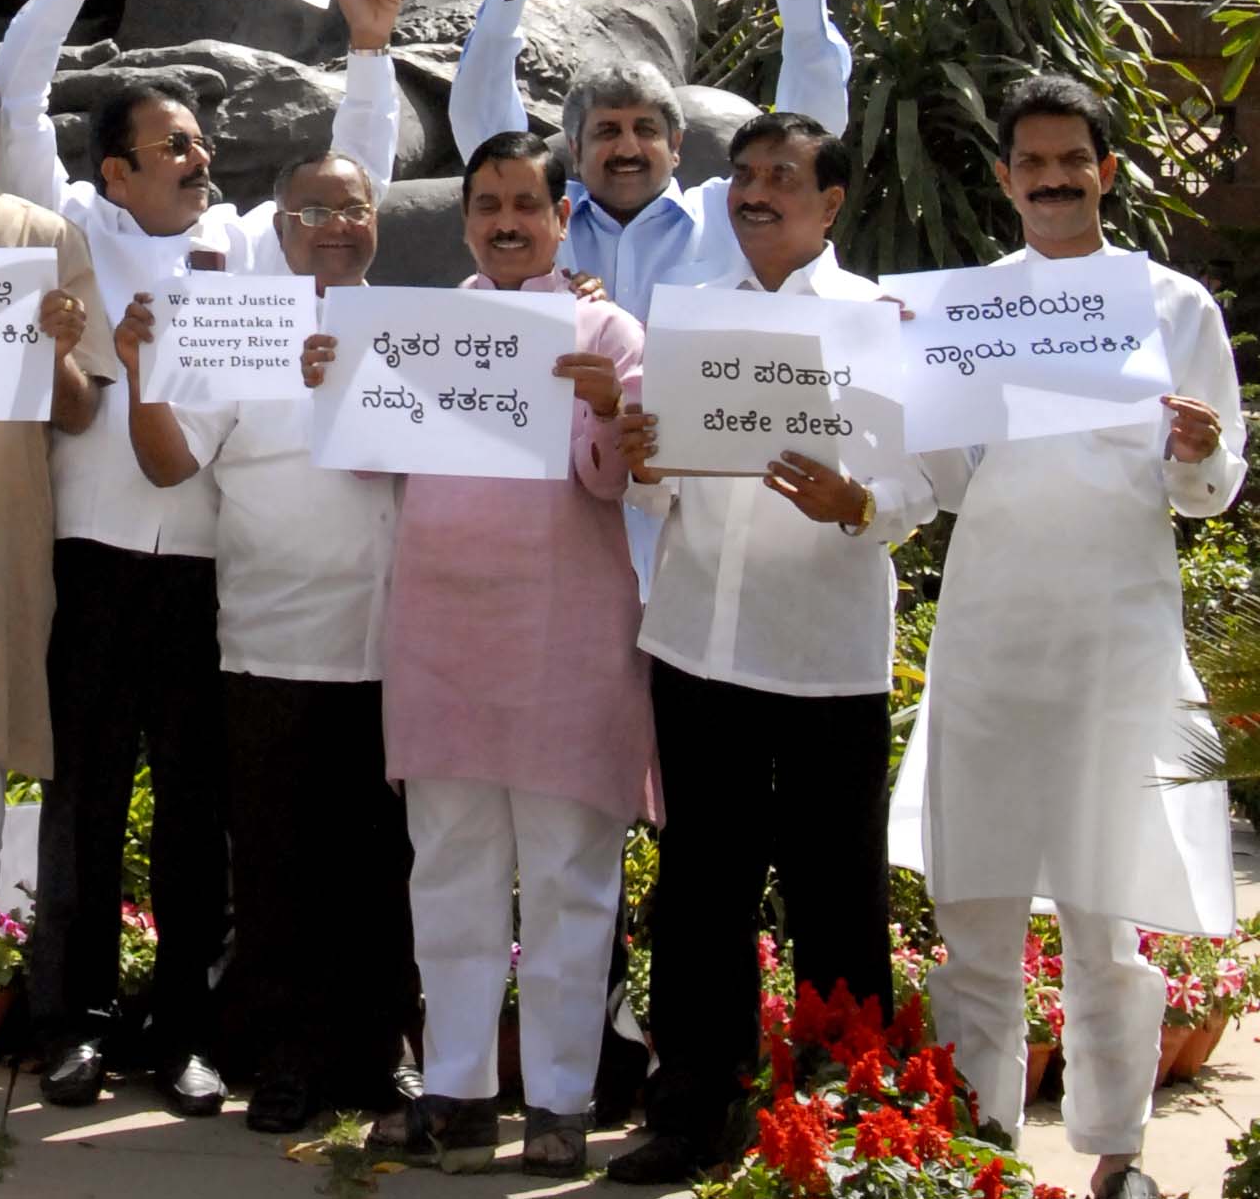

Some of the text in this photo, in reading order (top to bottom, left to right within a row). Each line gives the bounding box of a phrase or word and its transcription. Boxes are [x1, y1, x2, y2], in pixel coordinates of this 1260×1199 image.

[168, 294, 296, 305] We want Justice
[946, 291, 1105, 321] ಕಾವೇರಿಯಲ್ಲಿ
[172, 316, 294, 328] to Karnataka in
[178, 336, 290, 349] Cauvery River
[373, 332, 518, 369] ರೈತರ ರಕ್ಷಣೆ
[925, 335, 1140, 376] ನ್ಯಾಯ ದೊರಕಿಸಿ
[179, 356, 289, 369] Water Dispute
[701, 358, 852, 386] ಬರ ಪರಿಹಾರ
[362, 385, 528, 427] ನಮ್ಮ ಕರ್ತವ್ಯ
[703, 408, 853, 436] ಬೇಕೇ ಬೇಕು
